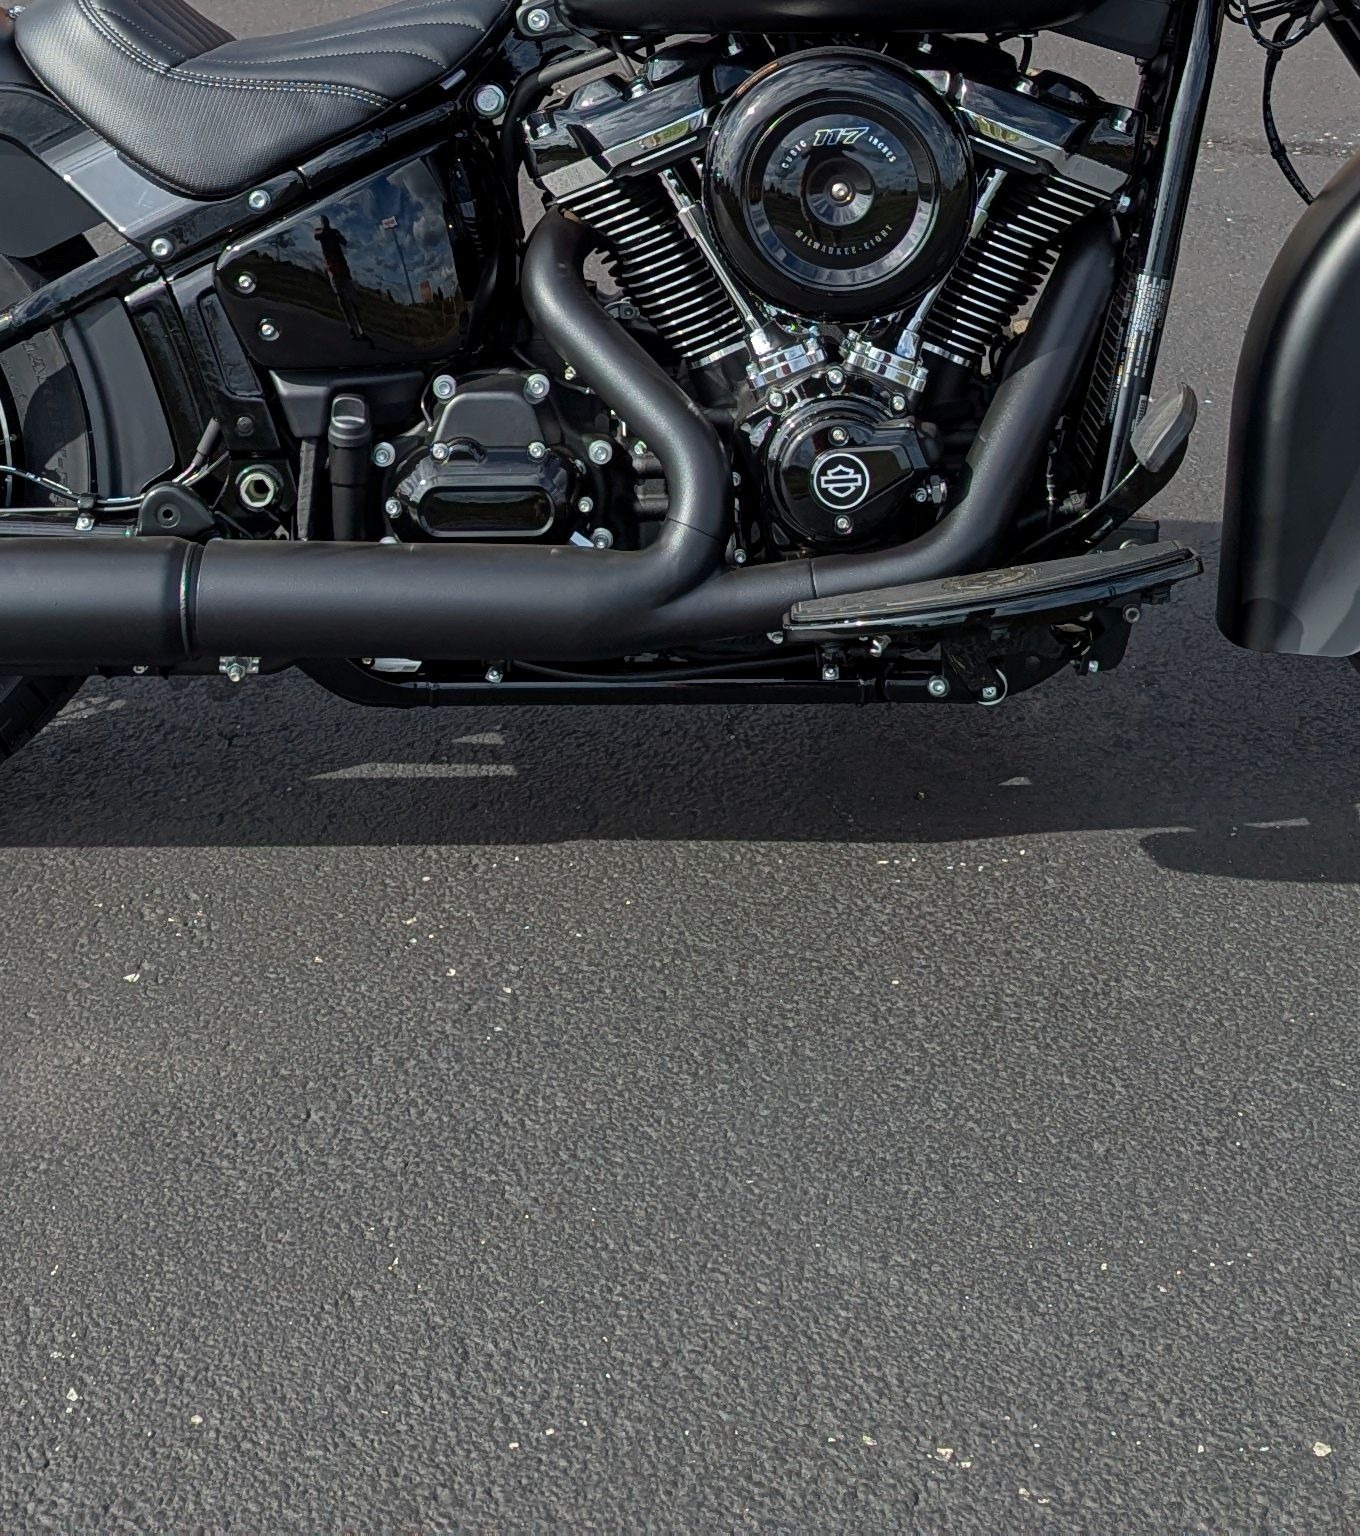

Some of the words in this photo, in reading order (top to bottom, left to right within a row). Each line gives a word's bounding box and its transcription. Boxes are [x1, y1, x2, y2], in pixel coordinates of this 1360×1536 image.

[781, 139, 807, 169] CUBIC
[812, 126, 870, 147] 117
[868, 135, 897, 163] INCHES
[794, 224, 893, 256] MILWAUKEE-EIGHT
